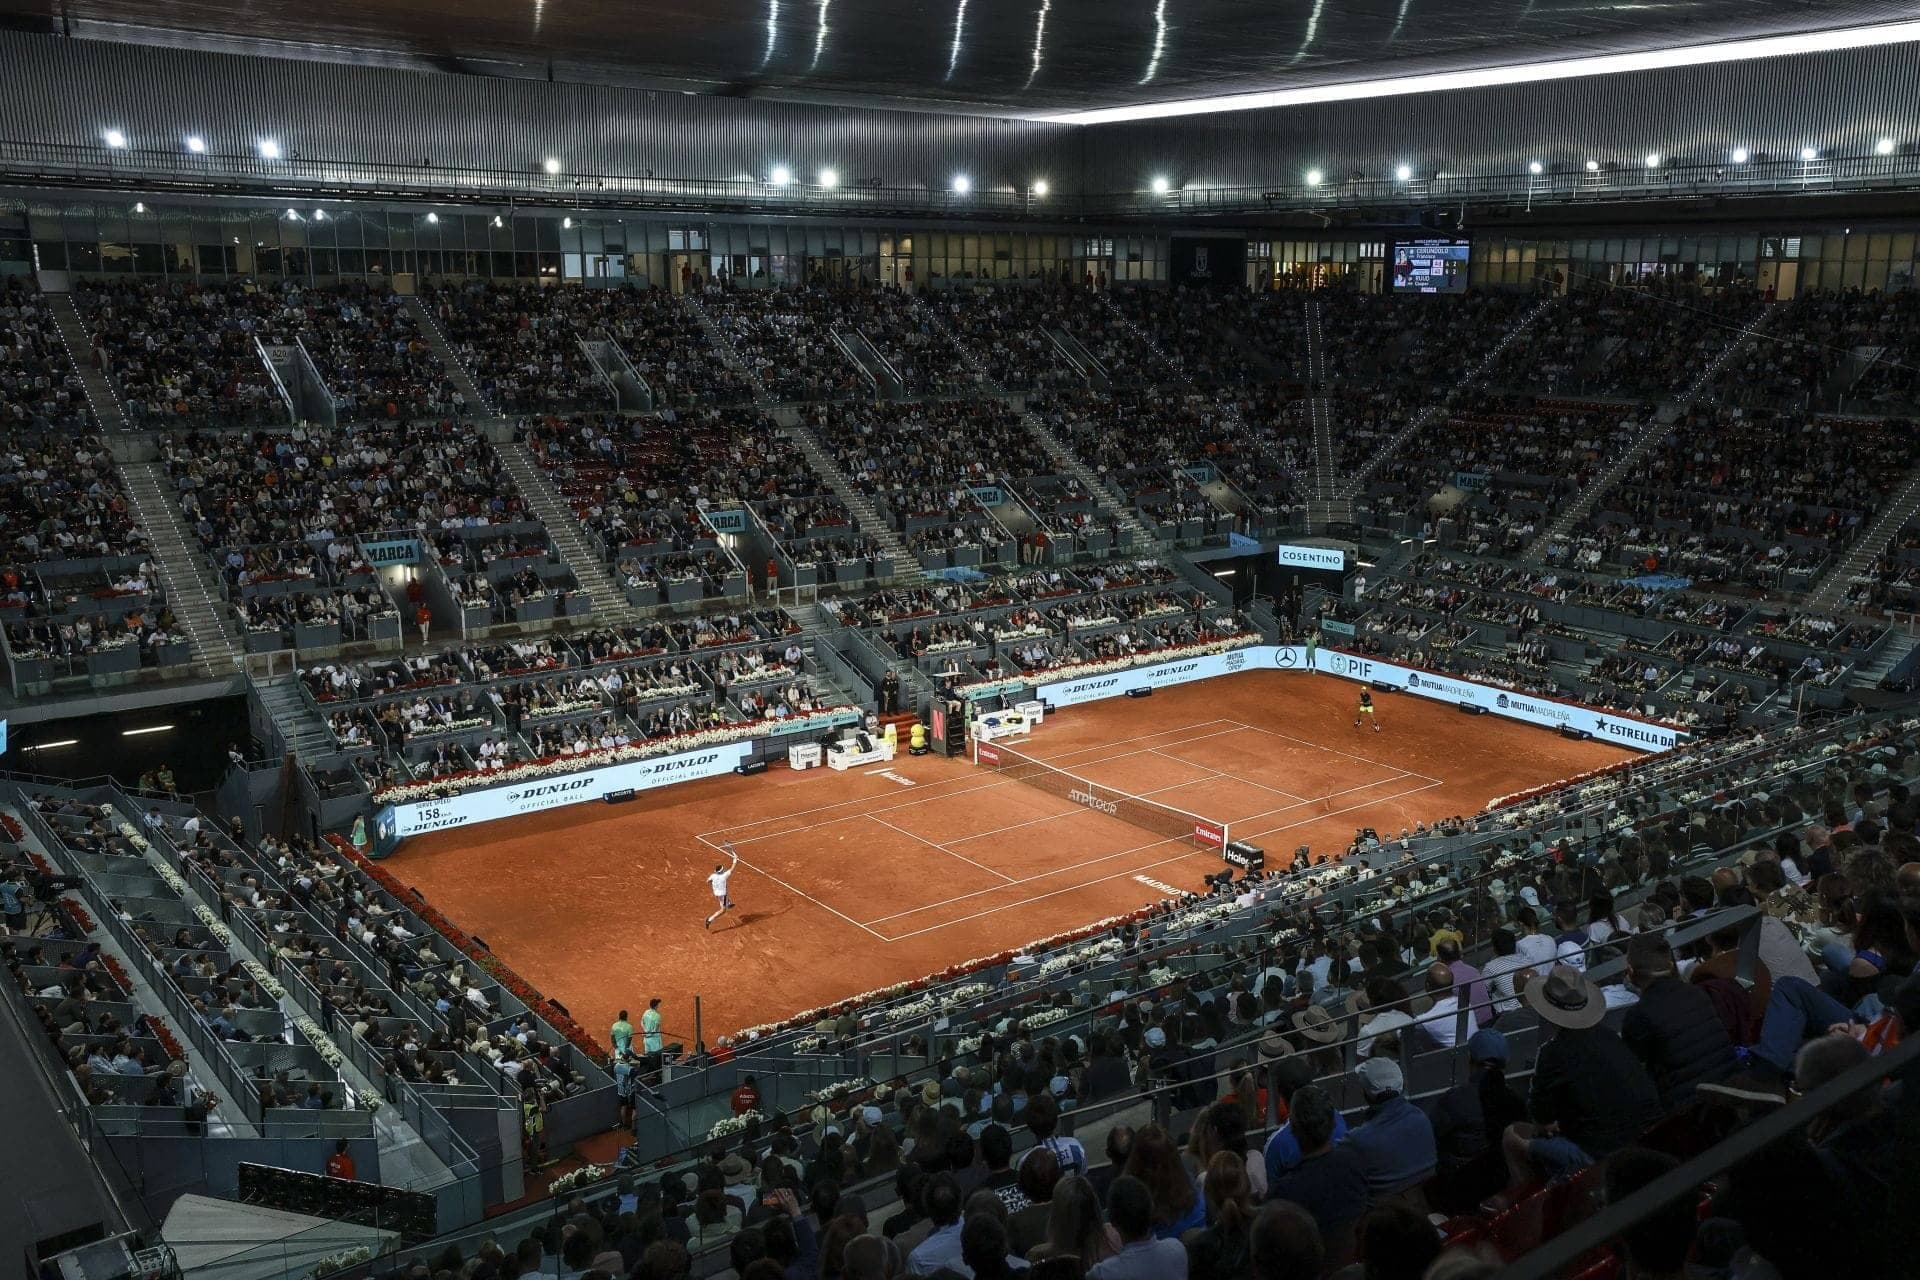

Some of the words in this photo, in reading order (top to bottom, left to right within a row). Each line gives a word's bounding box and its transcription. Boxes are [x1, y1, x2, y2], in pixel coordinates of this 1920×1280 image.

[1282, 551, 1341, 565] COSENTINO
[1156, 663, 1198, 677] DUNLOP
[1348, 659, 1372, 677] PIF
[1072, 678, 1118, 693] DUNLOP
[1610, 724, 1658, 745] ESTRELLA
[652, 754, 718, 774] DUNLOP
[651, 774, 688, 785] OFFICIAL
[691, 768, 709, 777] BALL
[523, 778, 594, 799] DUNLOP
[520, 799, 558, 810] OFFICIAL
[563, 793, 584, 803] BALL
[418, 808, 440, 821] 158
[413, 815, 467, 831] DUNLOP
[1195, 826, 1222, 842] Emirates
[1227, 849, 1249, 865] Haier
[1133, 875, 1182, 895] MADRID
